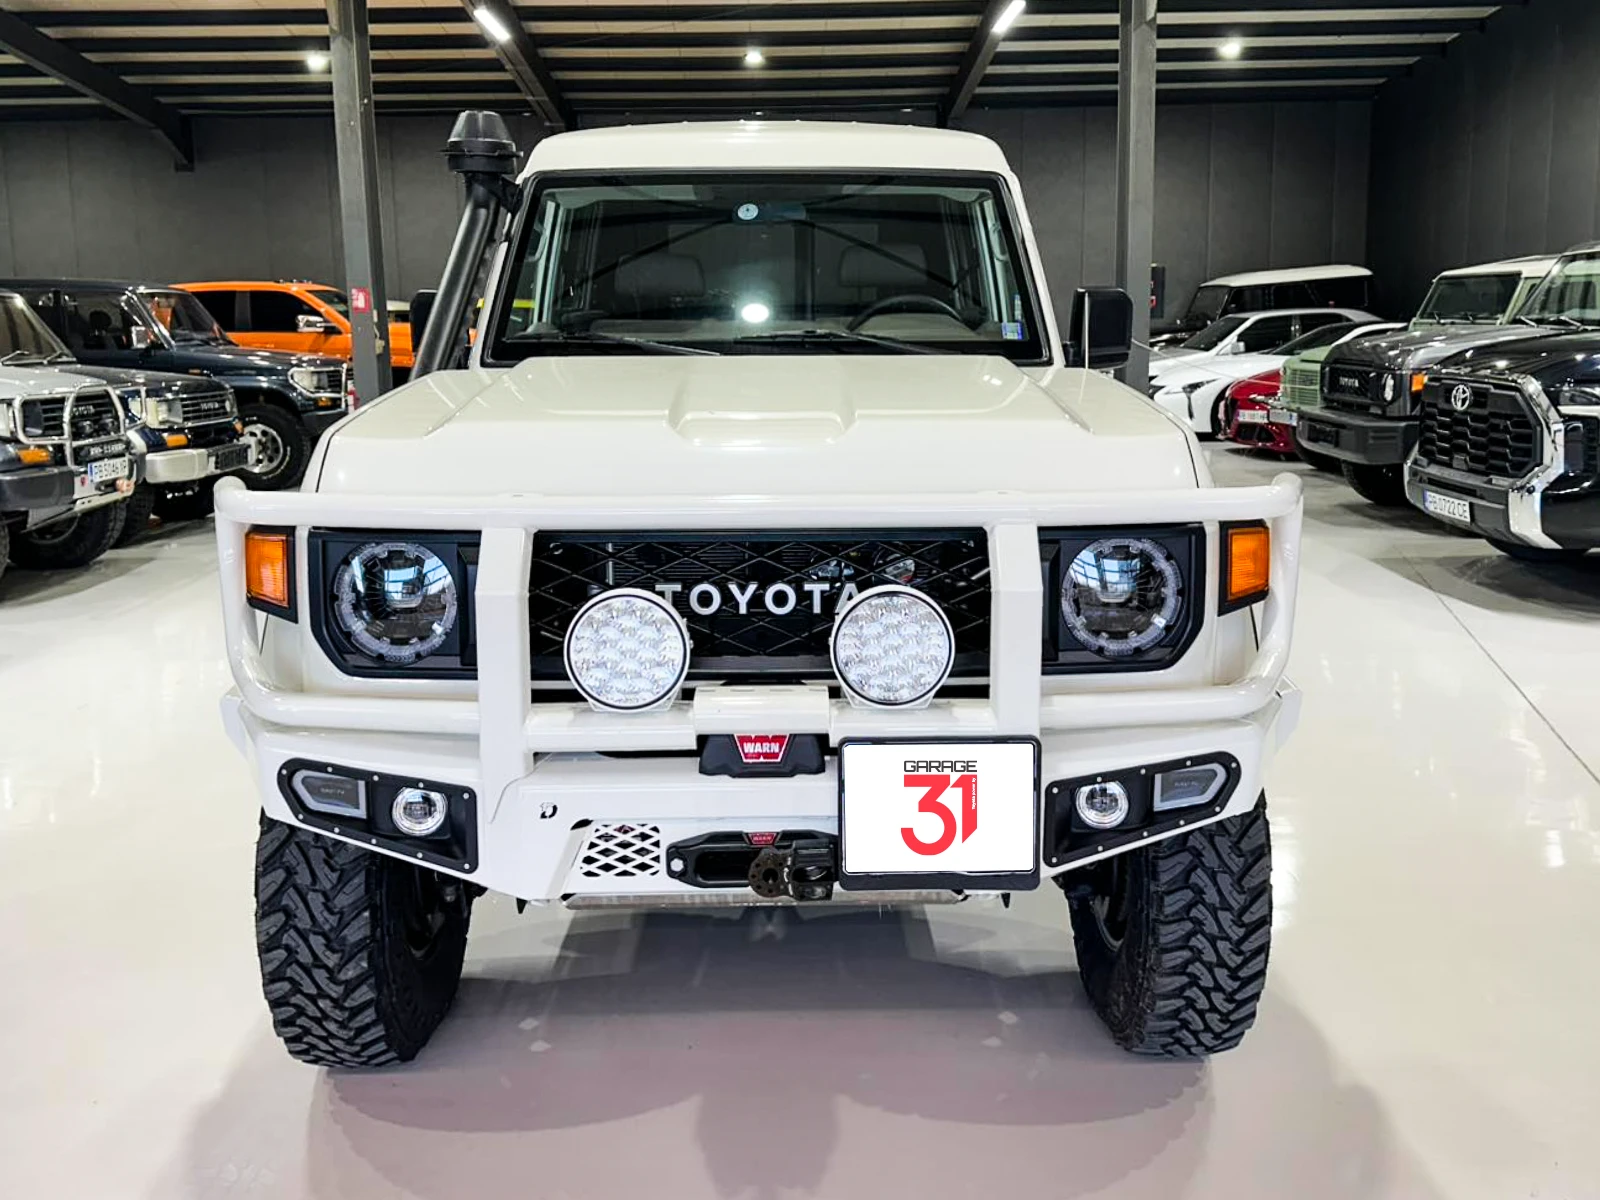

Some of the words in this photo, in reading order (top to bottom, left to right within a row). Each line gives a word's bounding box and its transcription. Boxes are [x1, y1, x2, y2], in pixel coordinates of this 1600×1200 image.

[71, 405, 95, 416] OYOTA
[655, 581, 860, 615] TOYOTA
[743, 742, 780, 753] WARN
